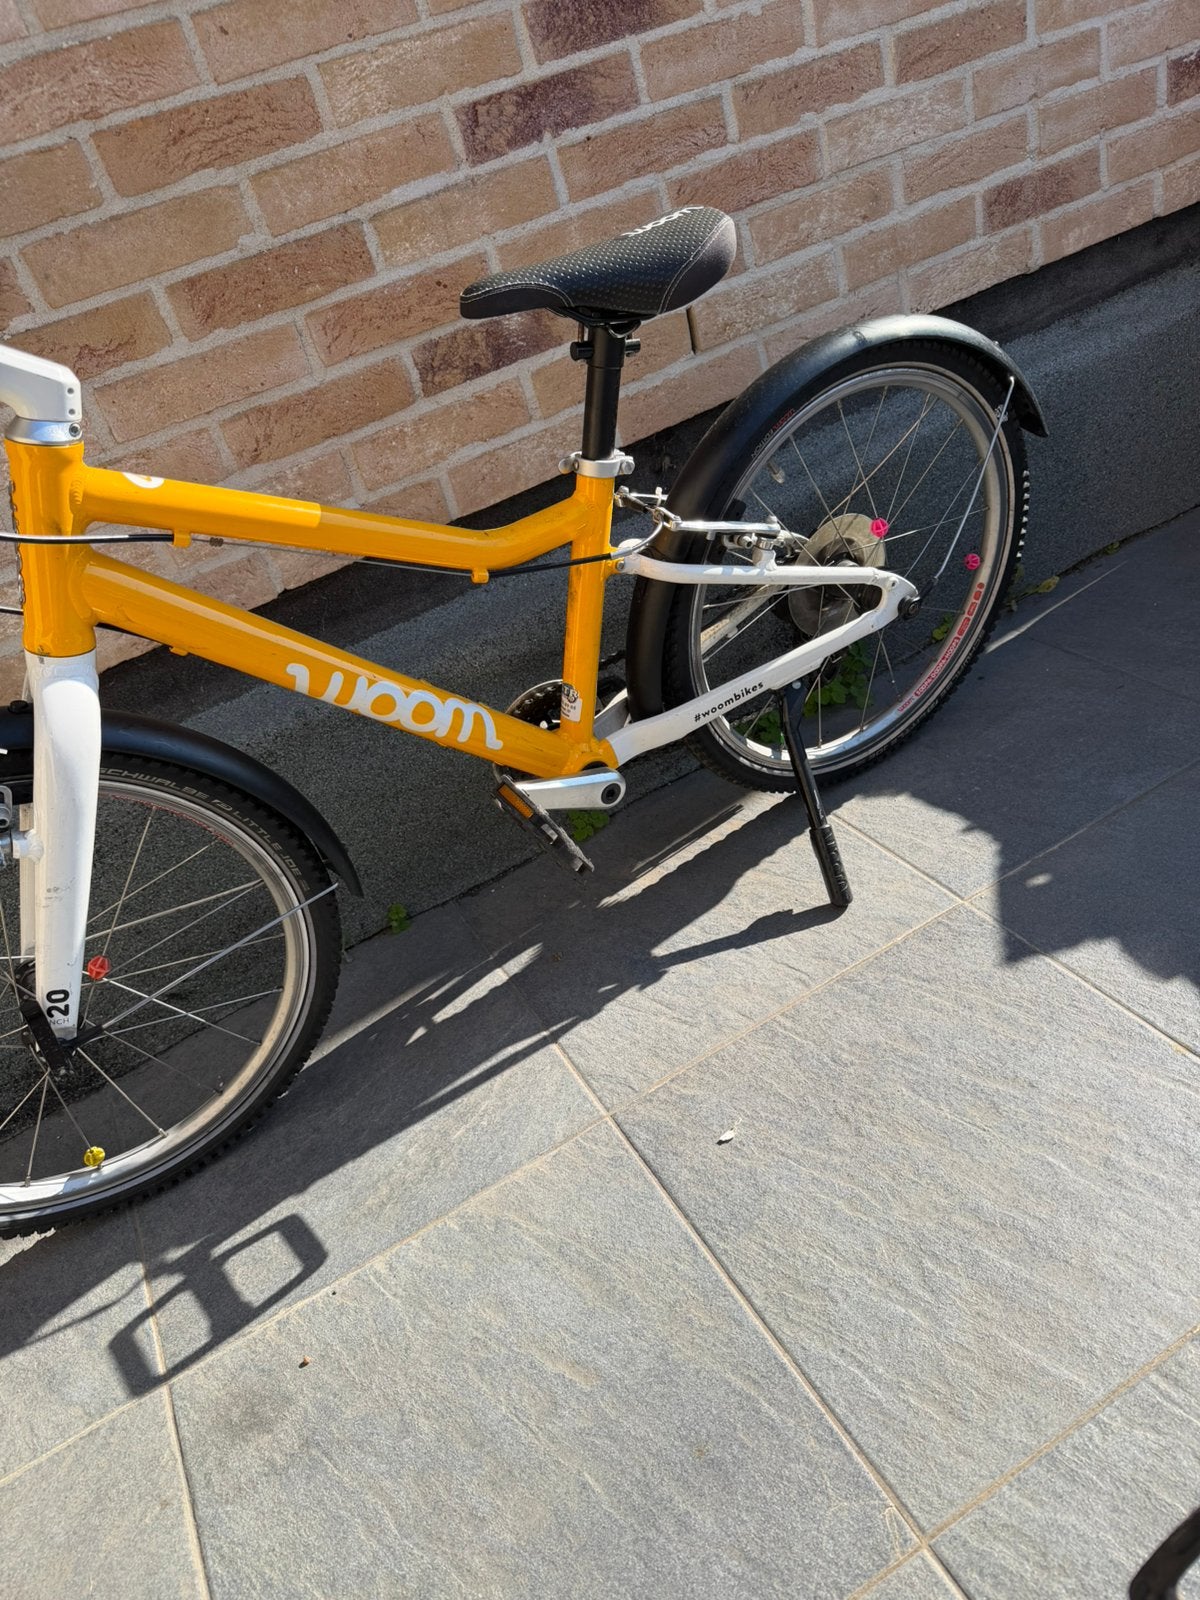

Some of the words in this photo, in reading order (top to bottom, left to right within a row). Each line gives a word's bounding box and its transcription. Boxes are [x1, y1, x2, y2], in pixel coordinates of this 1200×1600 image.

[286, 663, 503, 750] woom
[694, 681, 764, 722] #woombikes
[233, 810, 282, 851] LITTLE
[282, 855, 302, 877] JOE
[46, 989, 70, 1018] 20
[49, 1018, 70, 1026] NCH
